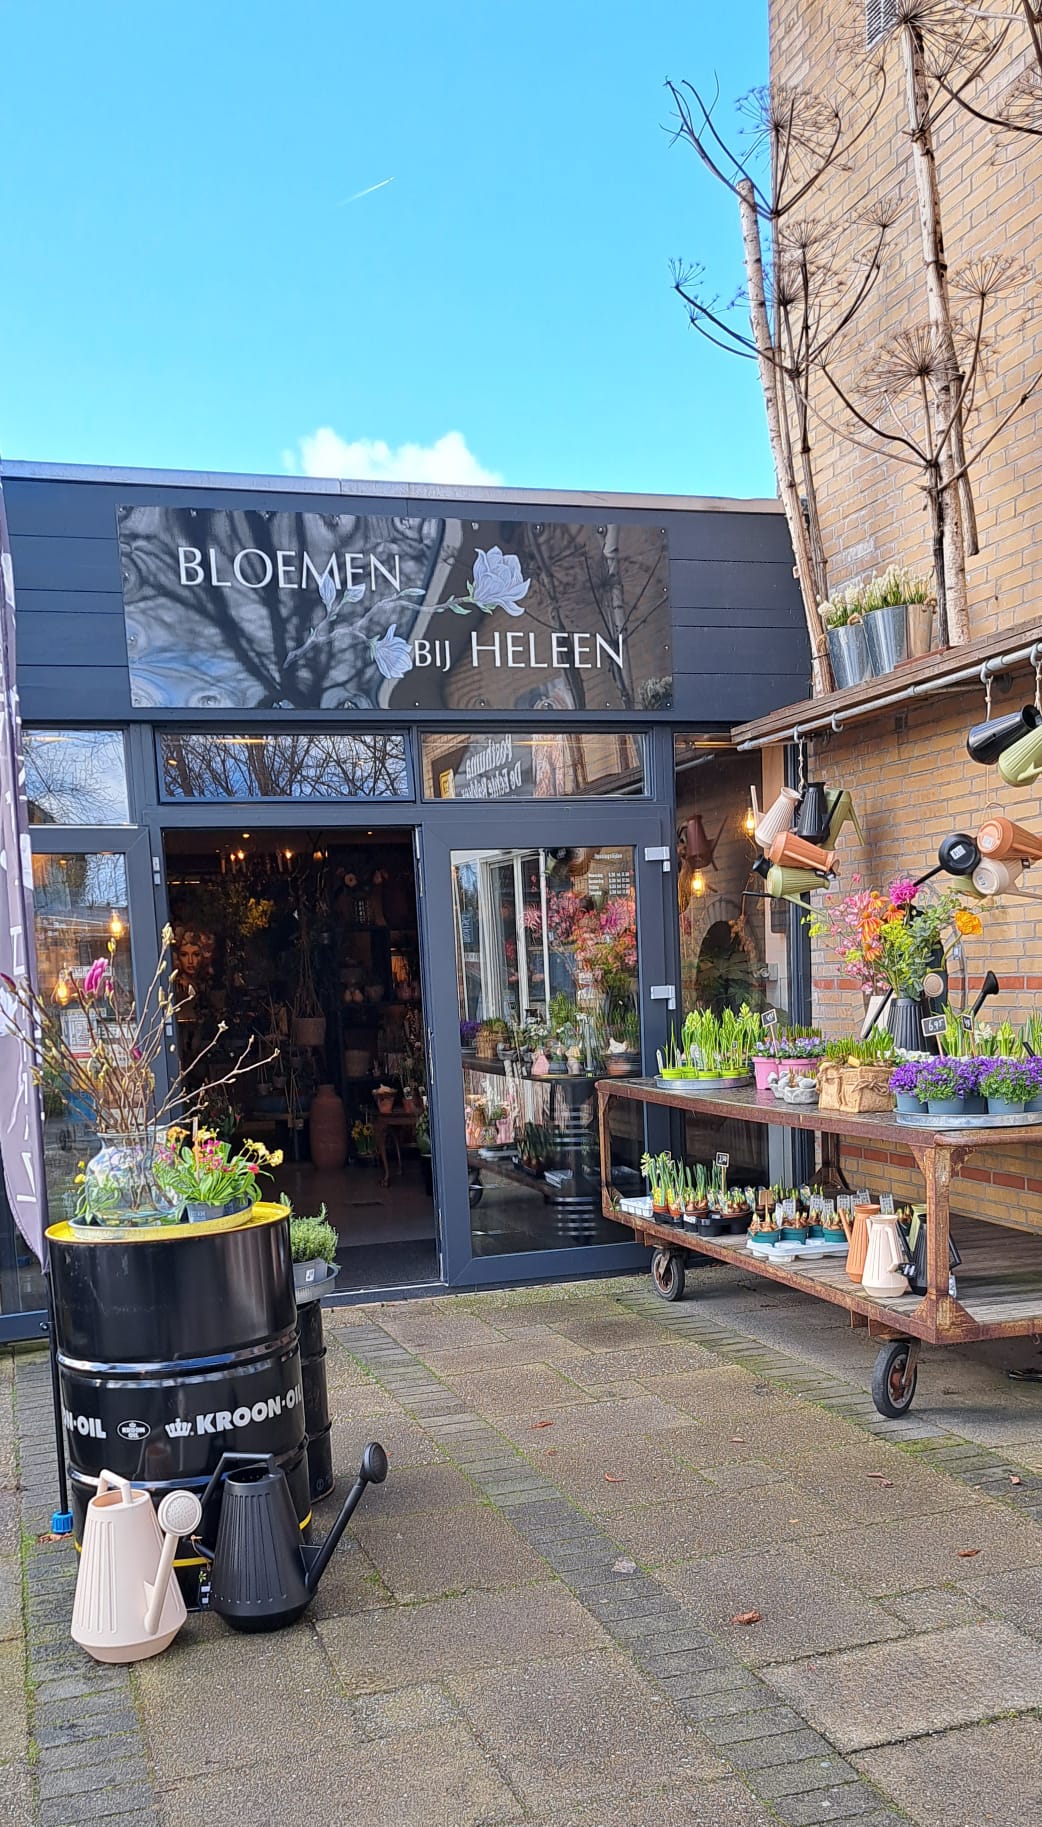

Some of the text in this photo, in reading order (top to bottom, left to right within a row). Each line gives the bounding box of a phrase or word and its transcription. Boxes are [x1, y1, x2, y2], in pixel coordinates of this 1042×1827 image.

[178, 546, 401, 592] BLOEMEN
[414, 631, 623, 672] BIJ HELEEN
[63, 1408, 107, 1439] N-OIL
